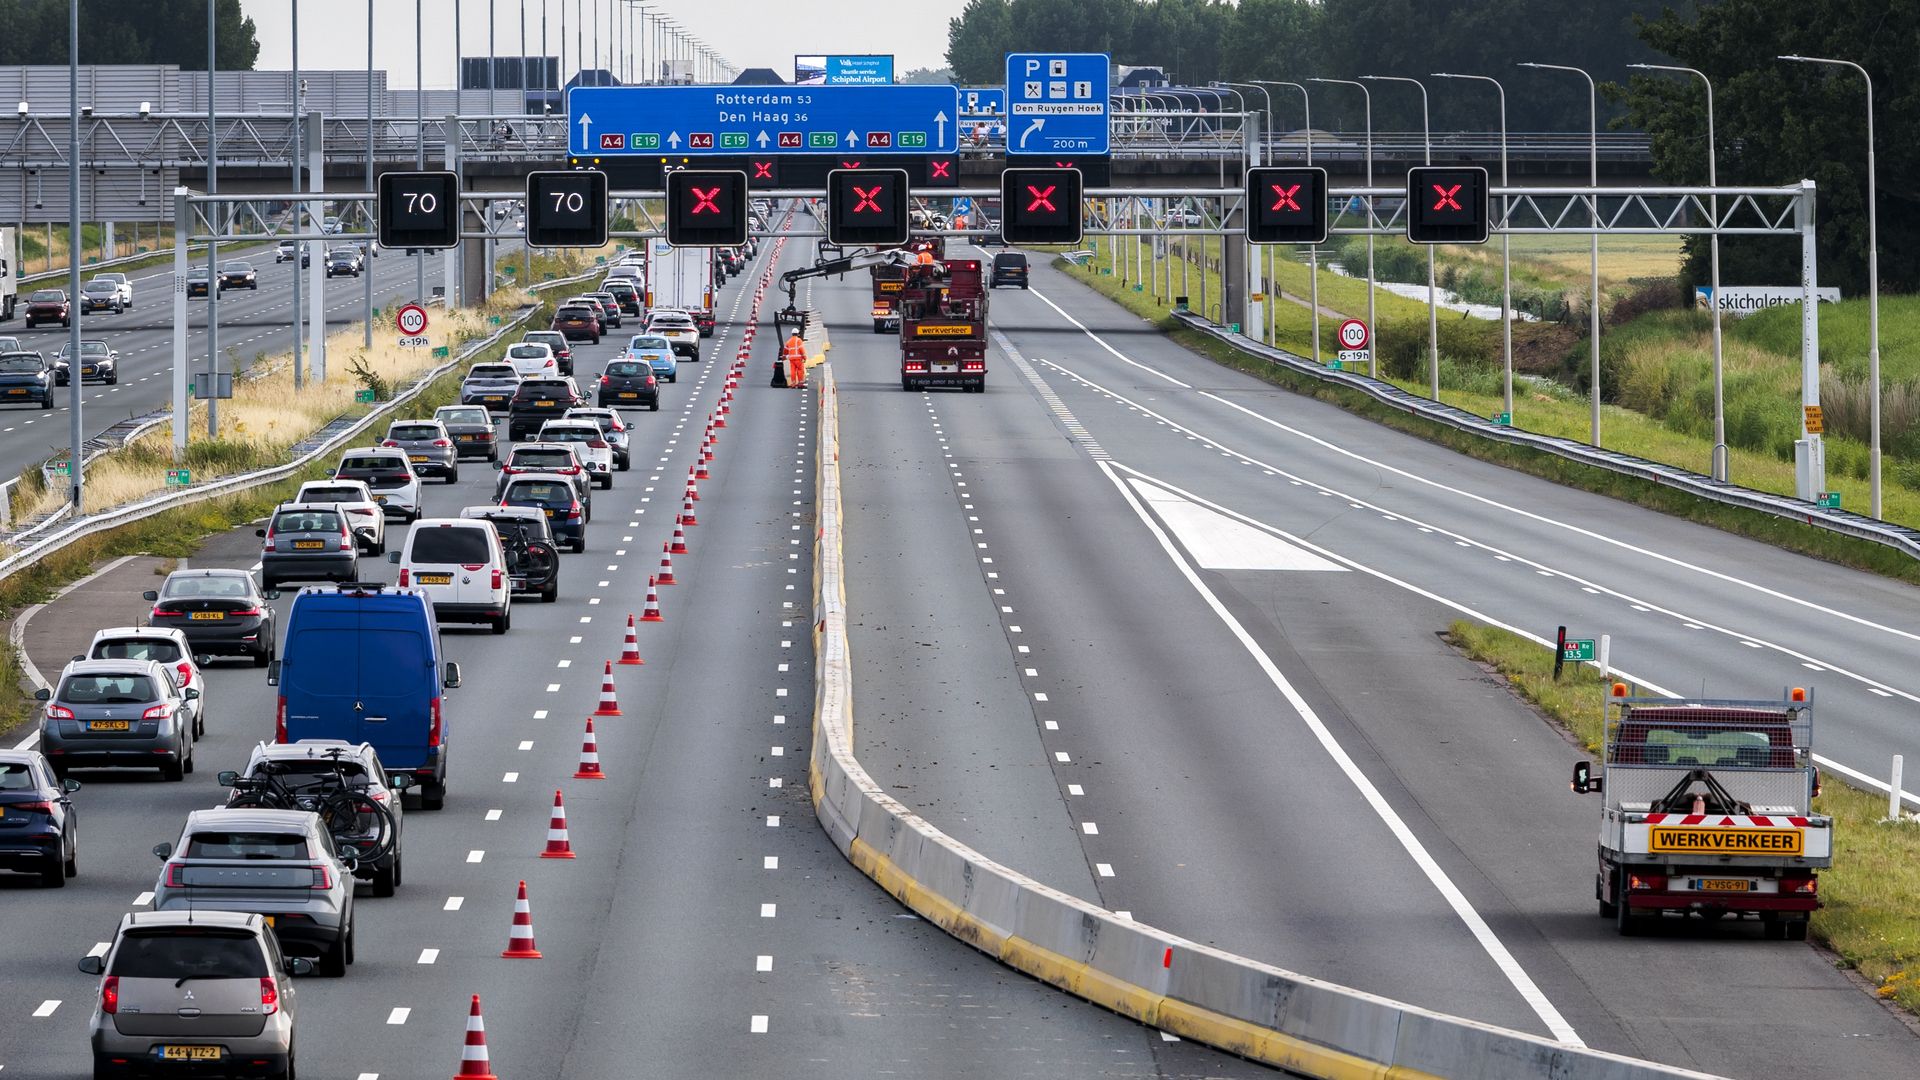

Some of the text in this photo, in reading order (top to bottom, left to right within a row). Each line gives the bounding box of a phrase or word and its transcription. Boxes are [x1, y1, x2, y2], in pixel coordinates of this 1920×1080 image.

[1026, 60, 1040, 77] P
[832, 75, 886, 84] Schiphol Airport
[716, 94, 812, 105] Rotterdam 53
[1037, 105, 1074, 113] Ruygen
[1077, 104, 1102, 112] Hoek
[719, 112, 808, 125] Den Haag 36
[603, 136, 623, 147] A4
[635, 136, 657, 146] E19
[692, 136, 712, 146] A4
[724, 135, 746, 146] E19
[781, 135, 800, 145] A4
[812, 134, 834, 145] E19
[868, 134, 889, 145] A4
[901, 134, 924, 145] E19
[1053, 139, 1088, 149] 200 m
[402, 193, 437, 213] 70
[549, 192, 584, 212] 70
[402, 314, 422, 327] 100
[1344, 328, 1364, 340] 100
[399, 337, 429, 346] 6-19h
[1340, 351, 1369, 360] 6-19h
[1659, 832, 1794, 850] WERKVERKEER
[1706, 881, 1744, 889] 2-VSG-91
